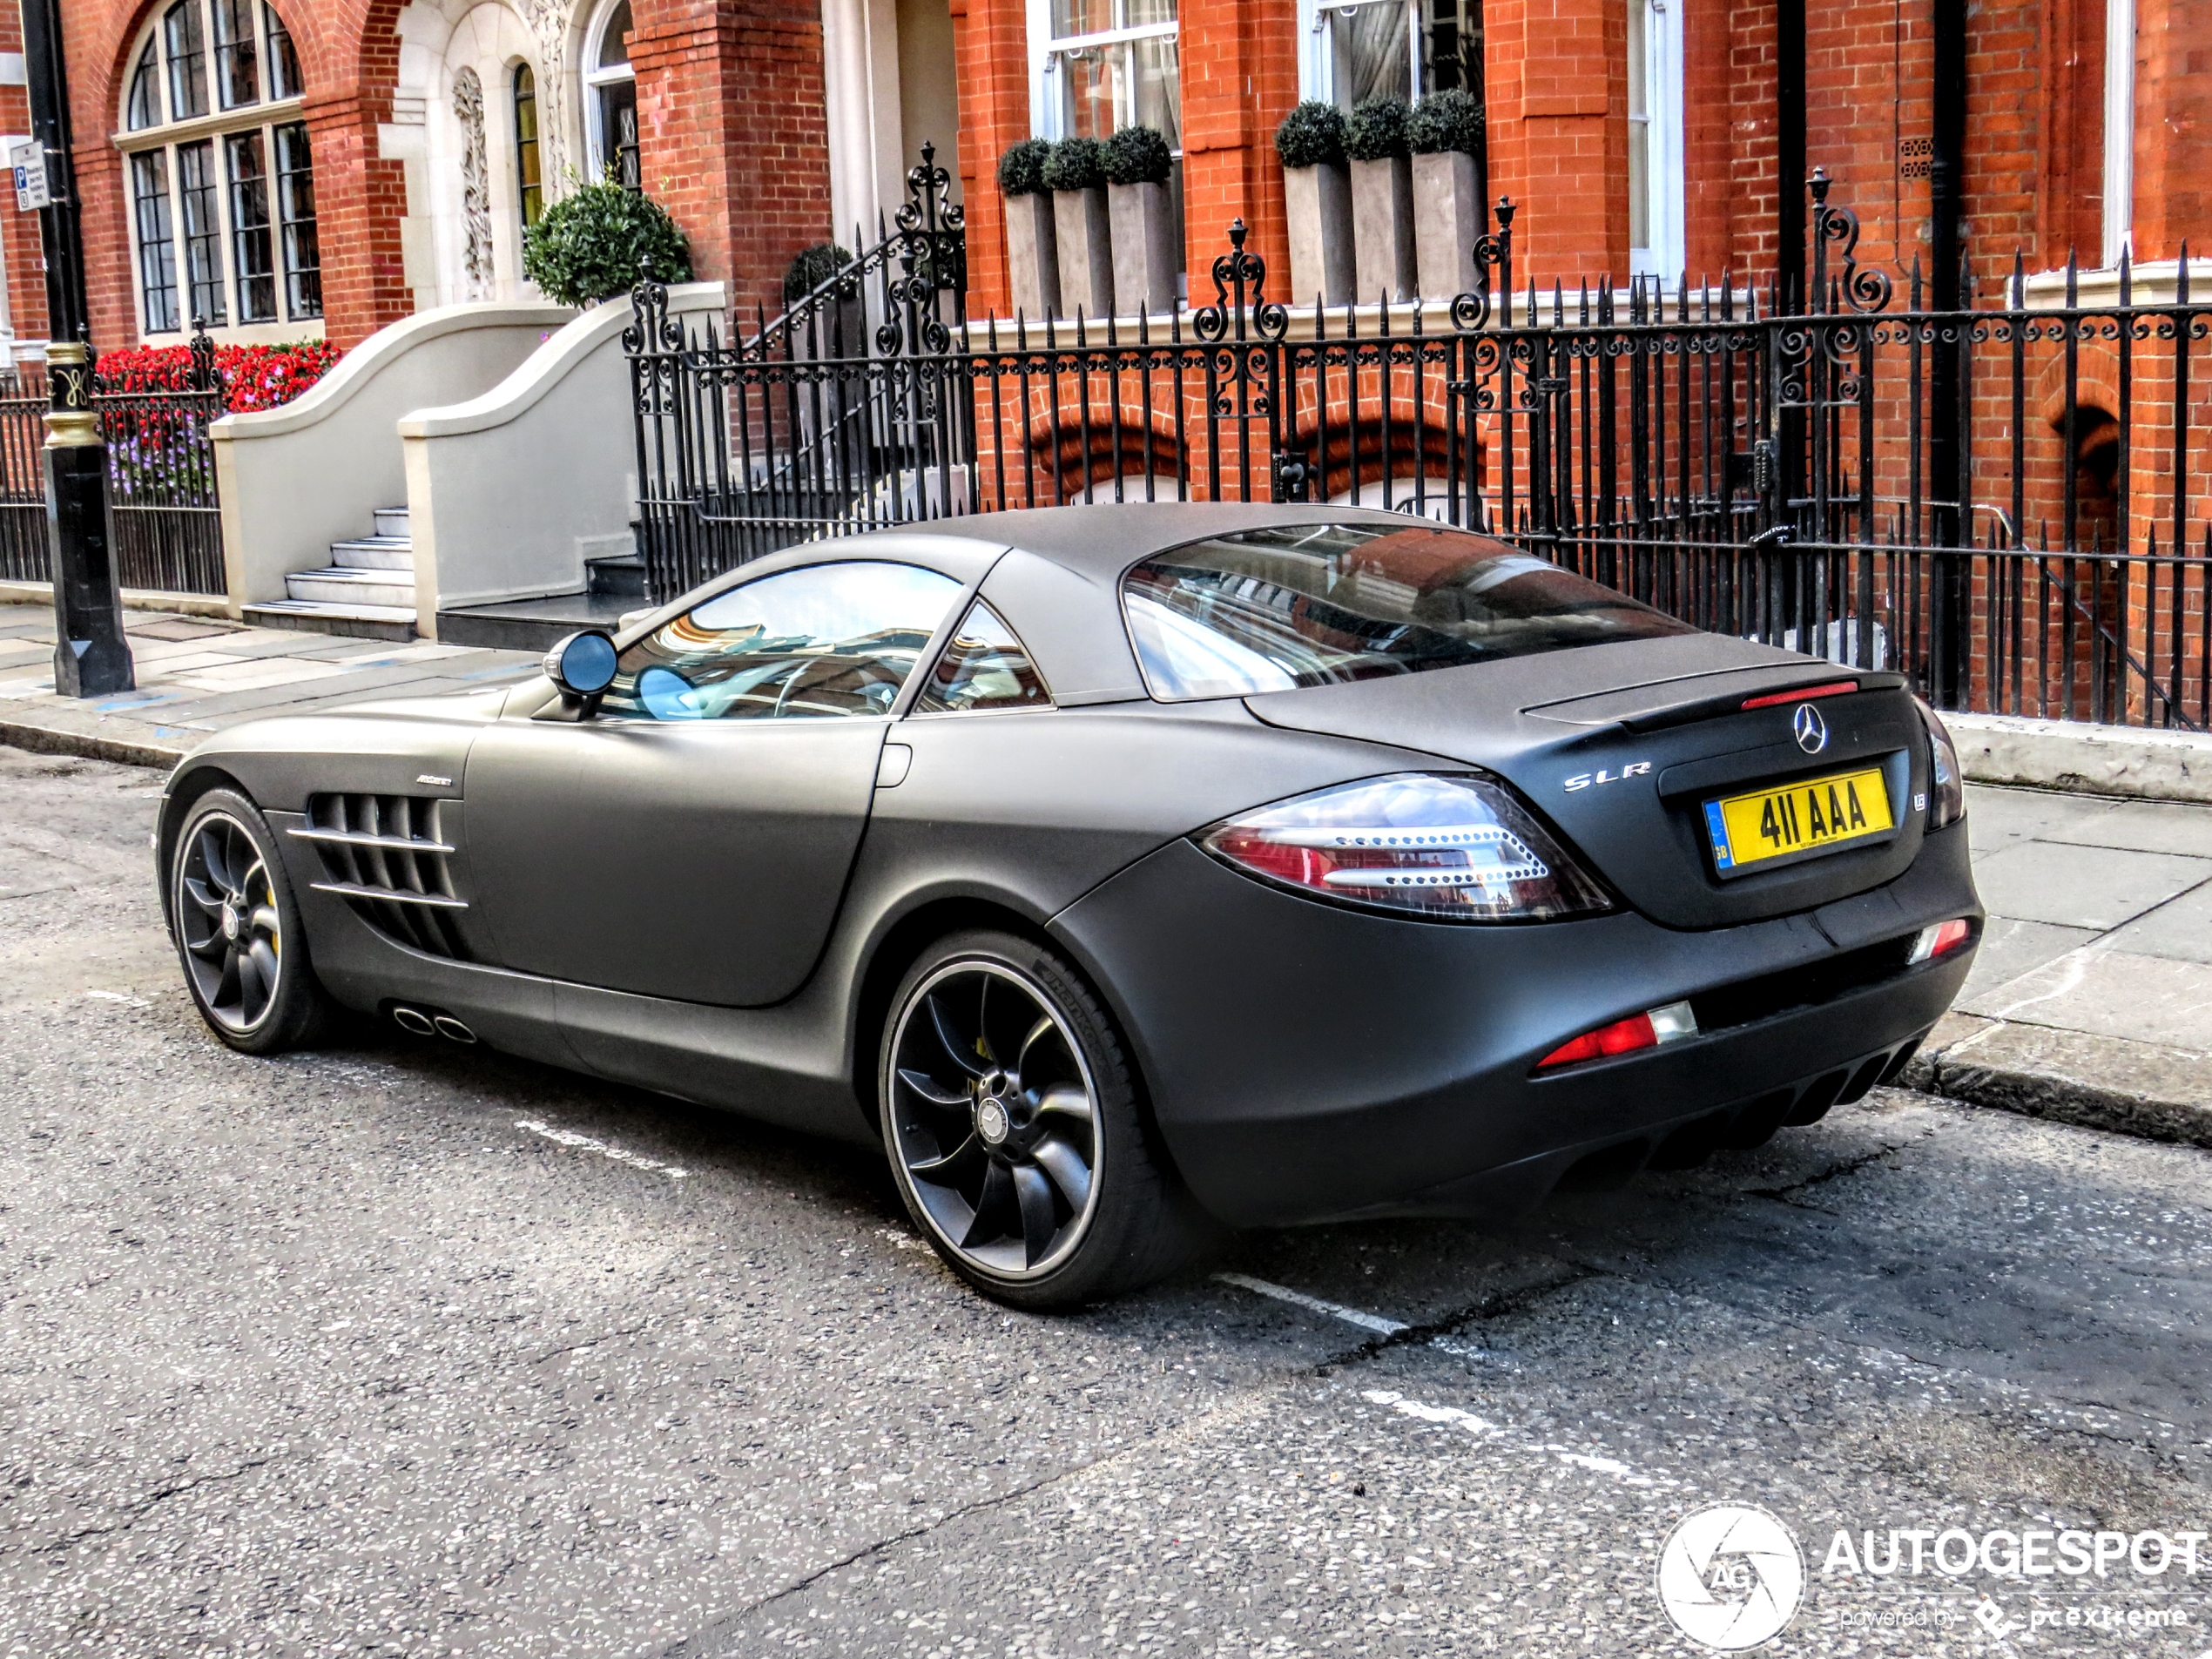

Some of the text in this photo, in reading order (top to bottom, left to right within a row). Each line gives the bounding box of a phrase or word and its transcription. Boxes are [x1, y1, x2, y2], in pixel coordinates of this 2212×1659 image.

[17, 168, 25, 187] P
[1564, 761, 1651, 792] SLR
[1760, 781, 1866, 848] 411 AAA
